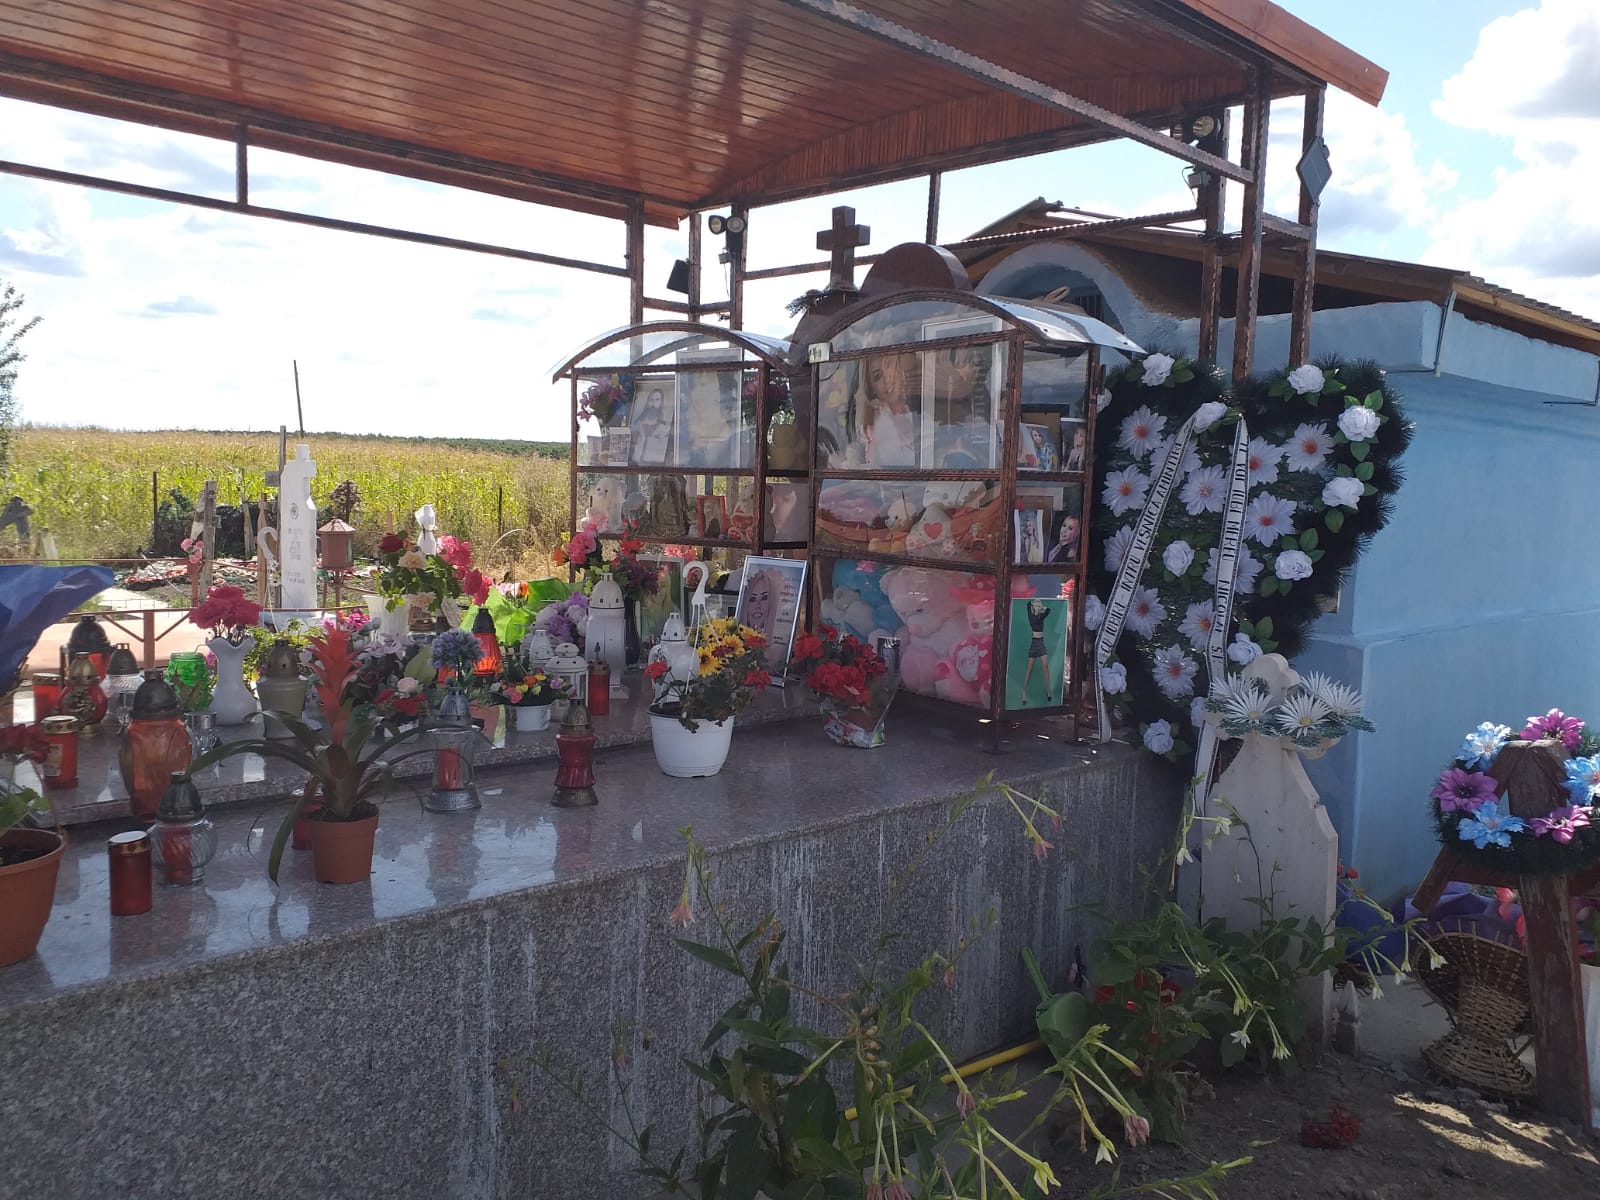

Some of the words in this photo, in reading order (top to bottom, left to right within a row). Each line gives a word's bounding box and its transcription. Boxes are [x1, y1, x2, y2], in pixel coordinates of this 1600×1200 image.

[1157, 442, 1183, 498] AMINTIRE
[1229, 489, 1245, 513] IUBI
[1220, 521, 1241, 560] MEREU
[1120, 555, 1142, 592] INTRU
[1105, 601, 1126, 637] IUBIRE
[1101, 637, 1113, 654] CU
